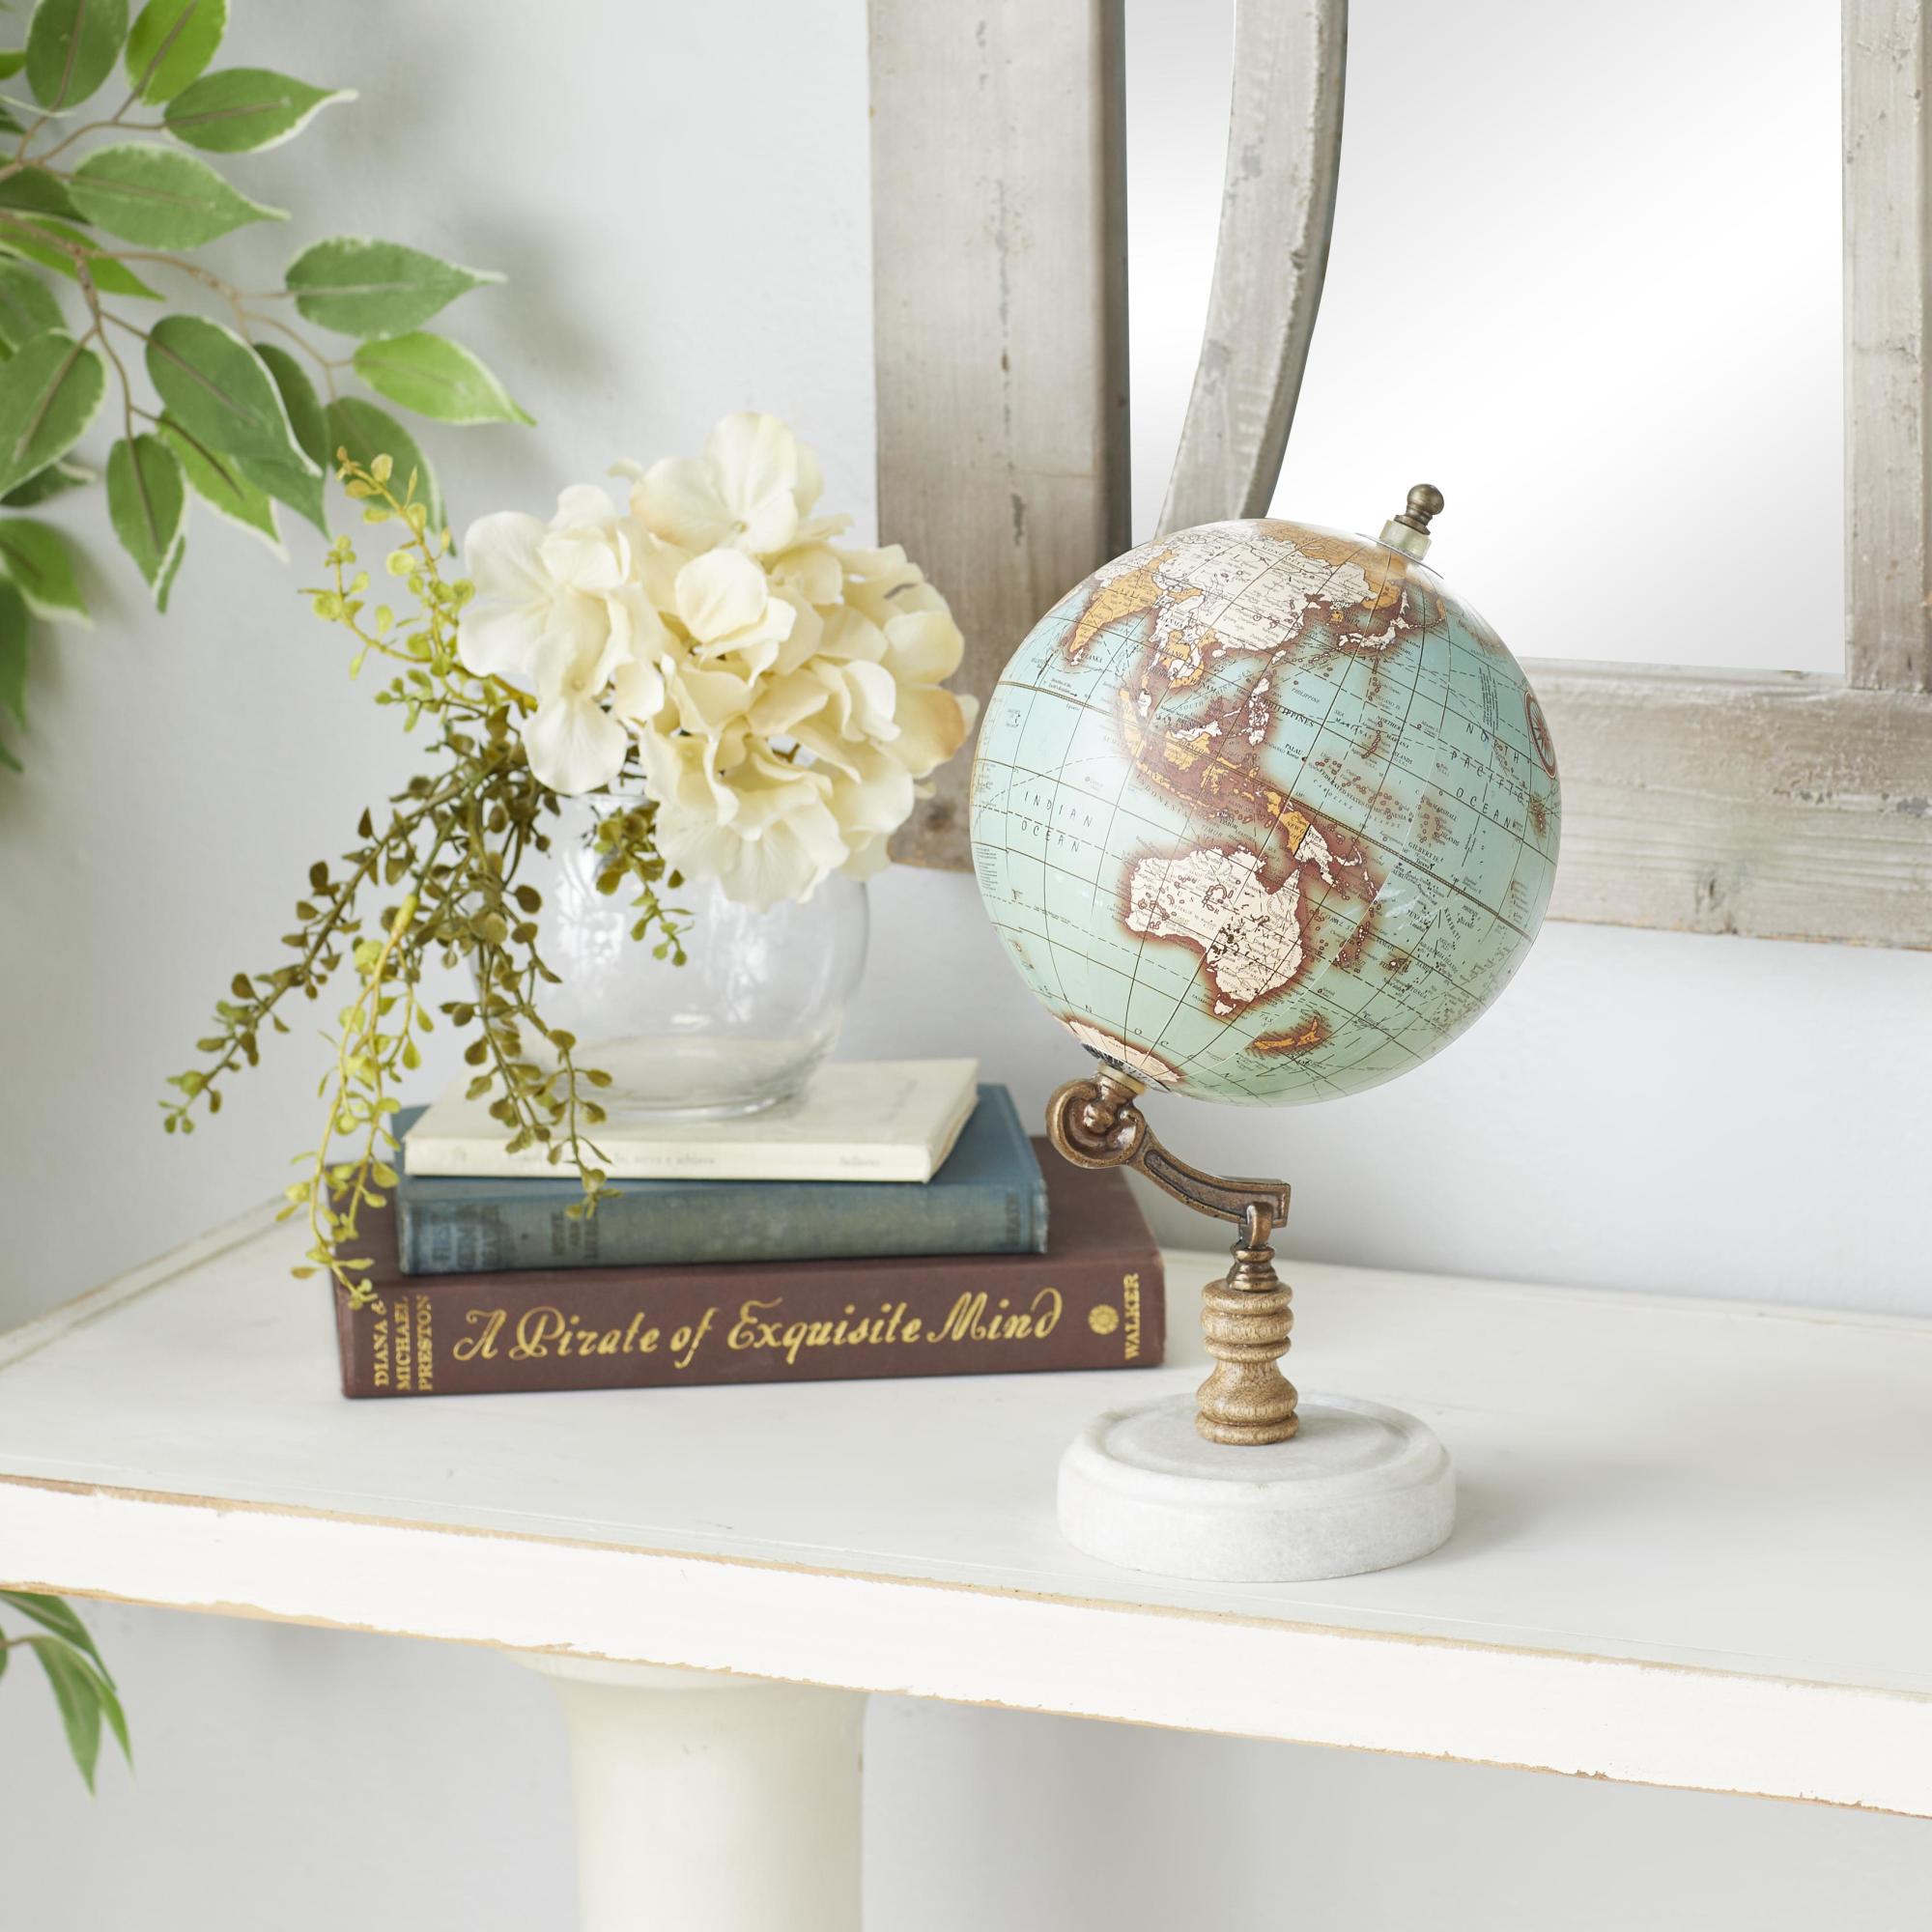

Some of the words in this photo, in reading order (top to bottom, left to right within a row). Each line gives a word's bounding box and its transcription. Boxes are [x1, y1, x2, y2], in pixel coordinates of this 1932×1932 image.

[1021, 819, 1081, 853] OCEAN
[1024, 790, 1094, 829] INDIAN
[1455, 786, 1513, 829] OCEAN
[373, 1319, 390, 1387] DIANA
[393, 1295, 412, 1390] MICHAEL
[416, 1294, 434, 1391] PRESTON
[452, 1308, 507, 1361] A
[508, 1305, 661, 1361] Pirate
[668, 1306, 720, 1369] of
[726, 1296, 923, 1366] Exquisite
[926, 1287, 1064, 1344] Mind
[1122, 1272, 1140, 1361] WALKER
